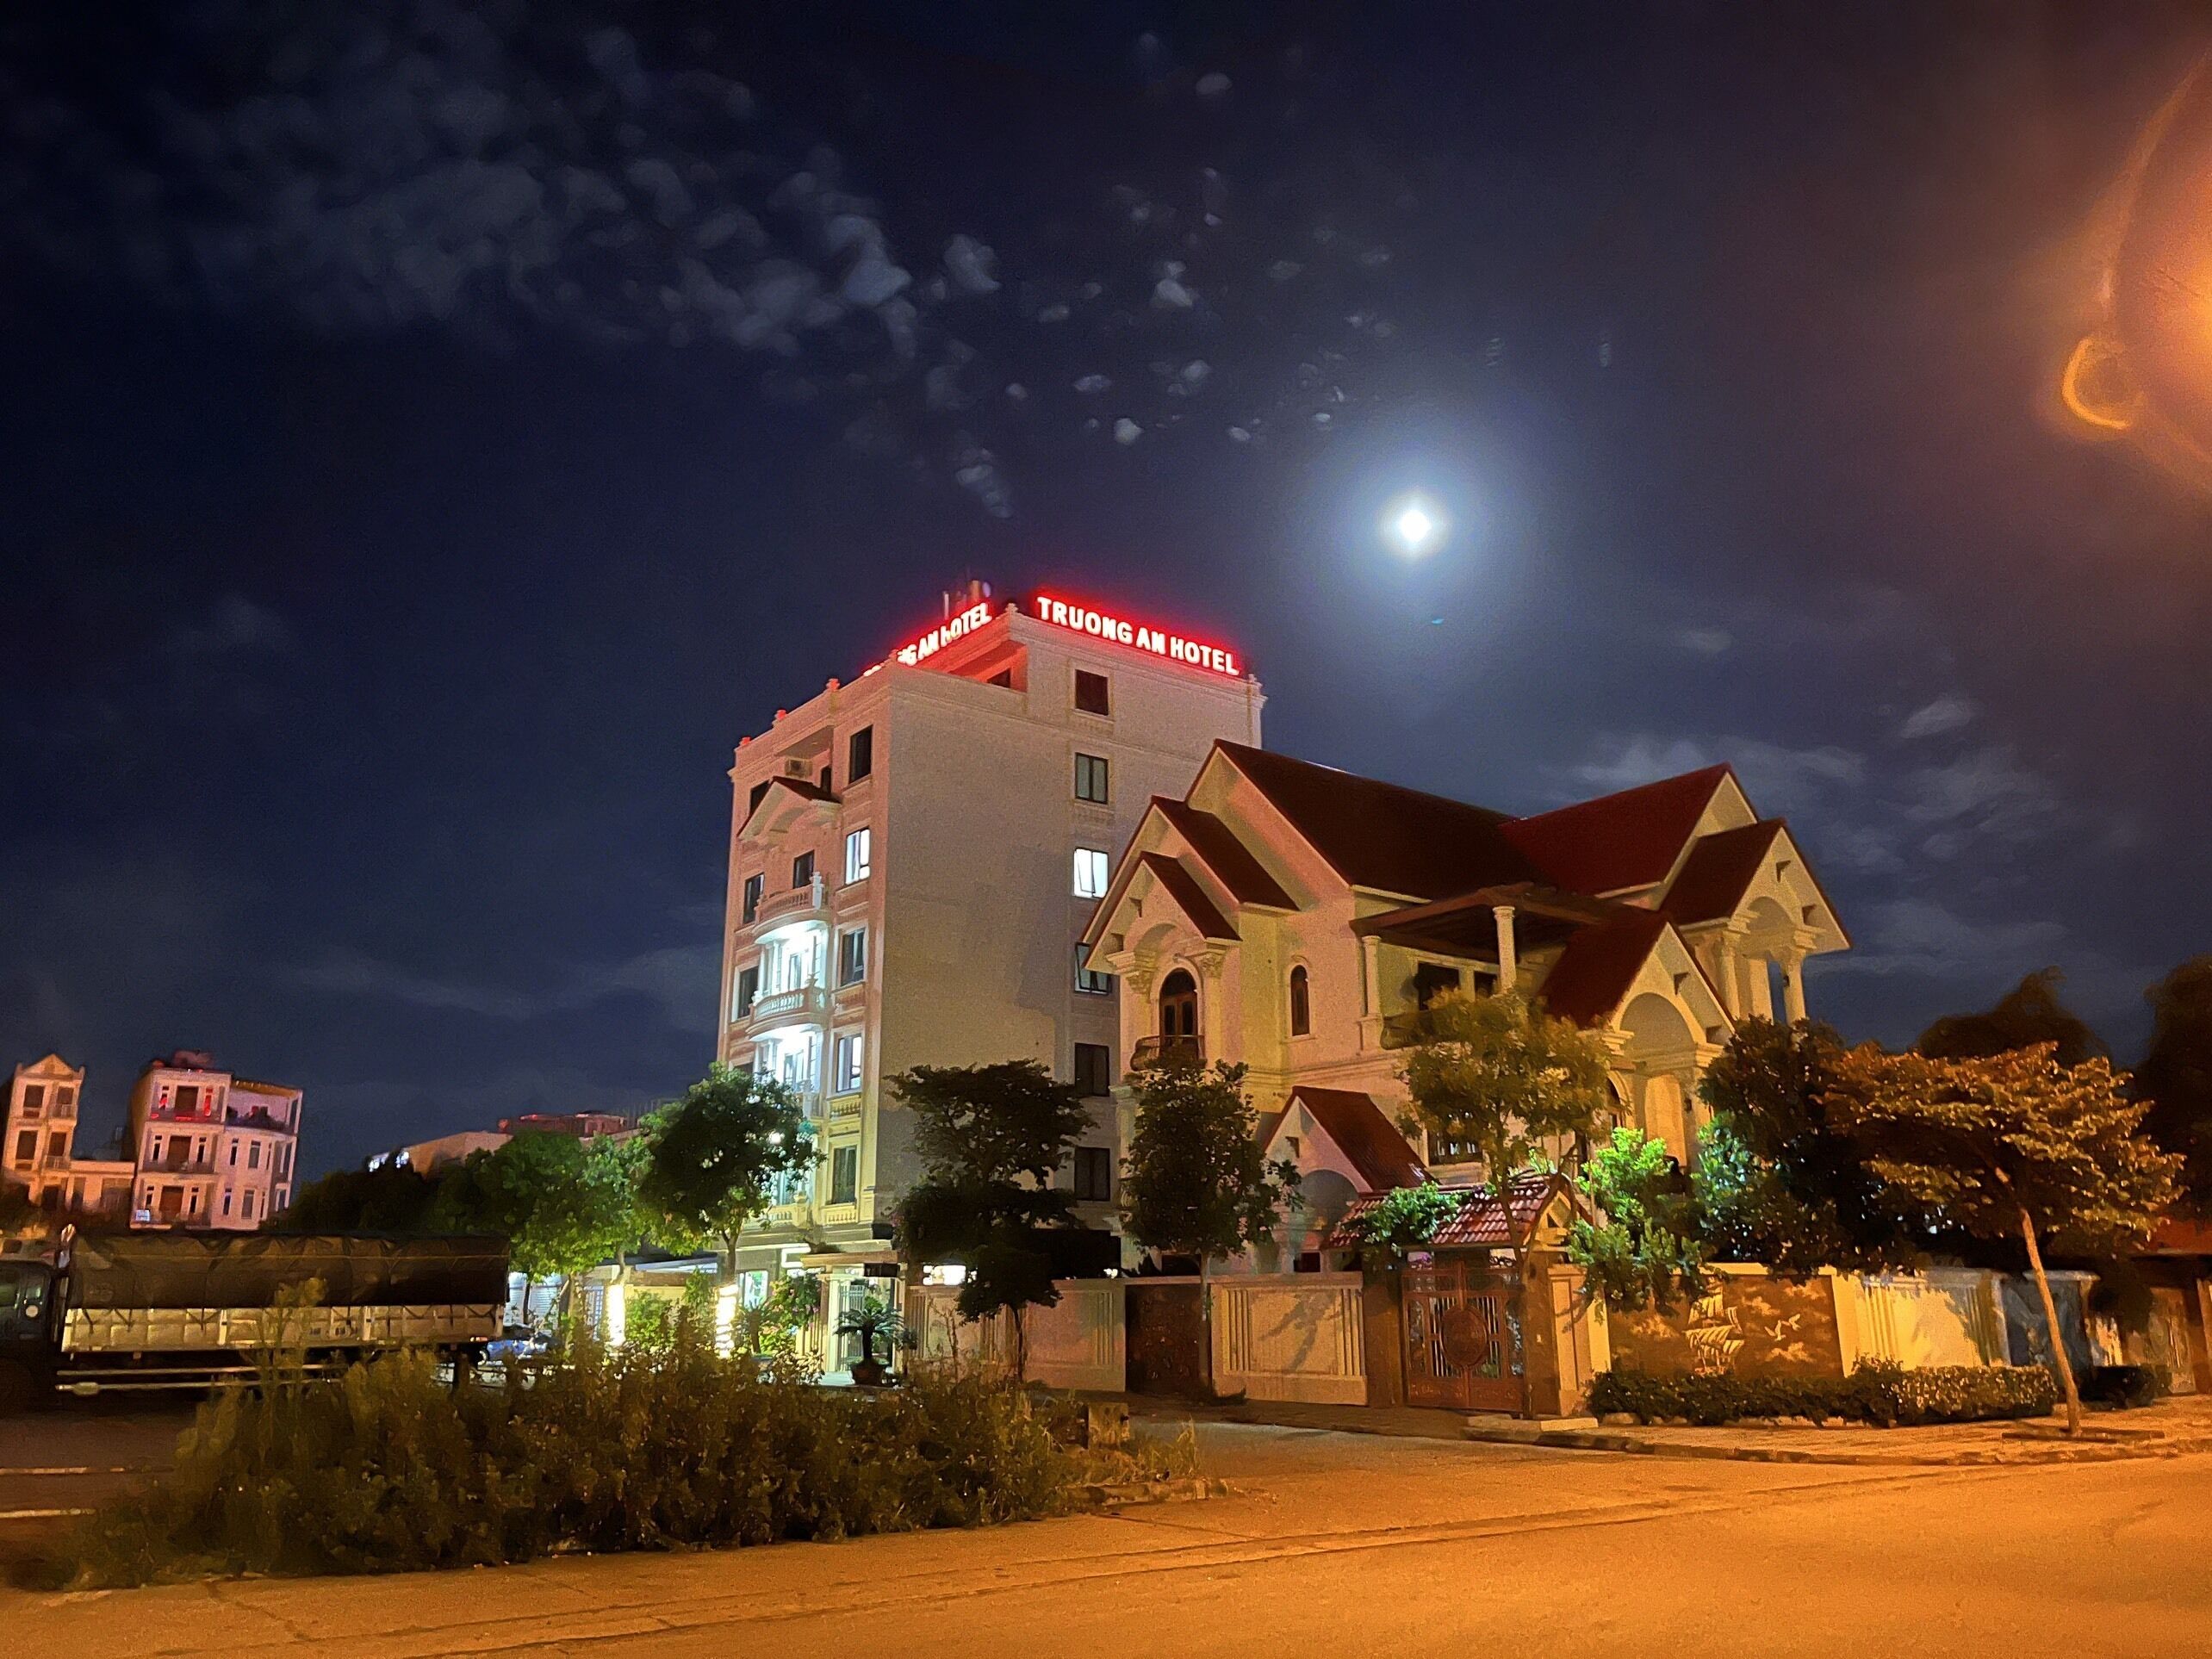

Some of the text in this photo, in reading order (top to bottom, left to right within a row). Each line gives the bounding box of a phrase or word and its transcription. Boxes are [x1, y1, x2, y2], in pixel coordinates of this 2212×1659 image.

[918, 631, 940, 661] AN
[1037, 596, 1240, 675] TRUONG AN HOTEL
